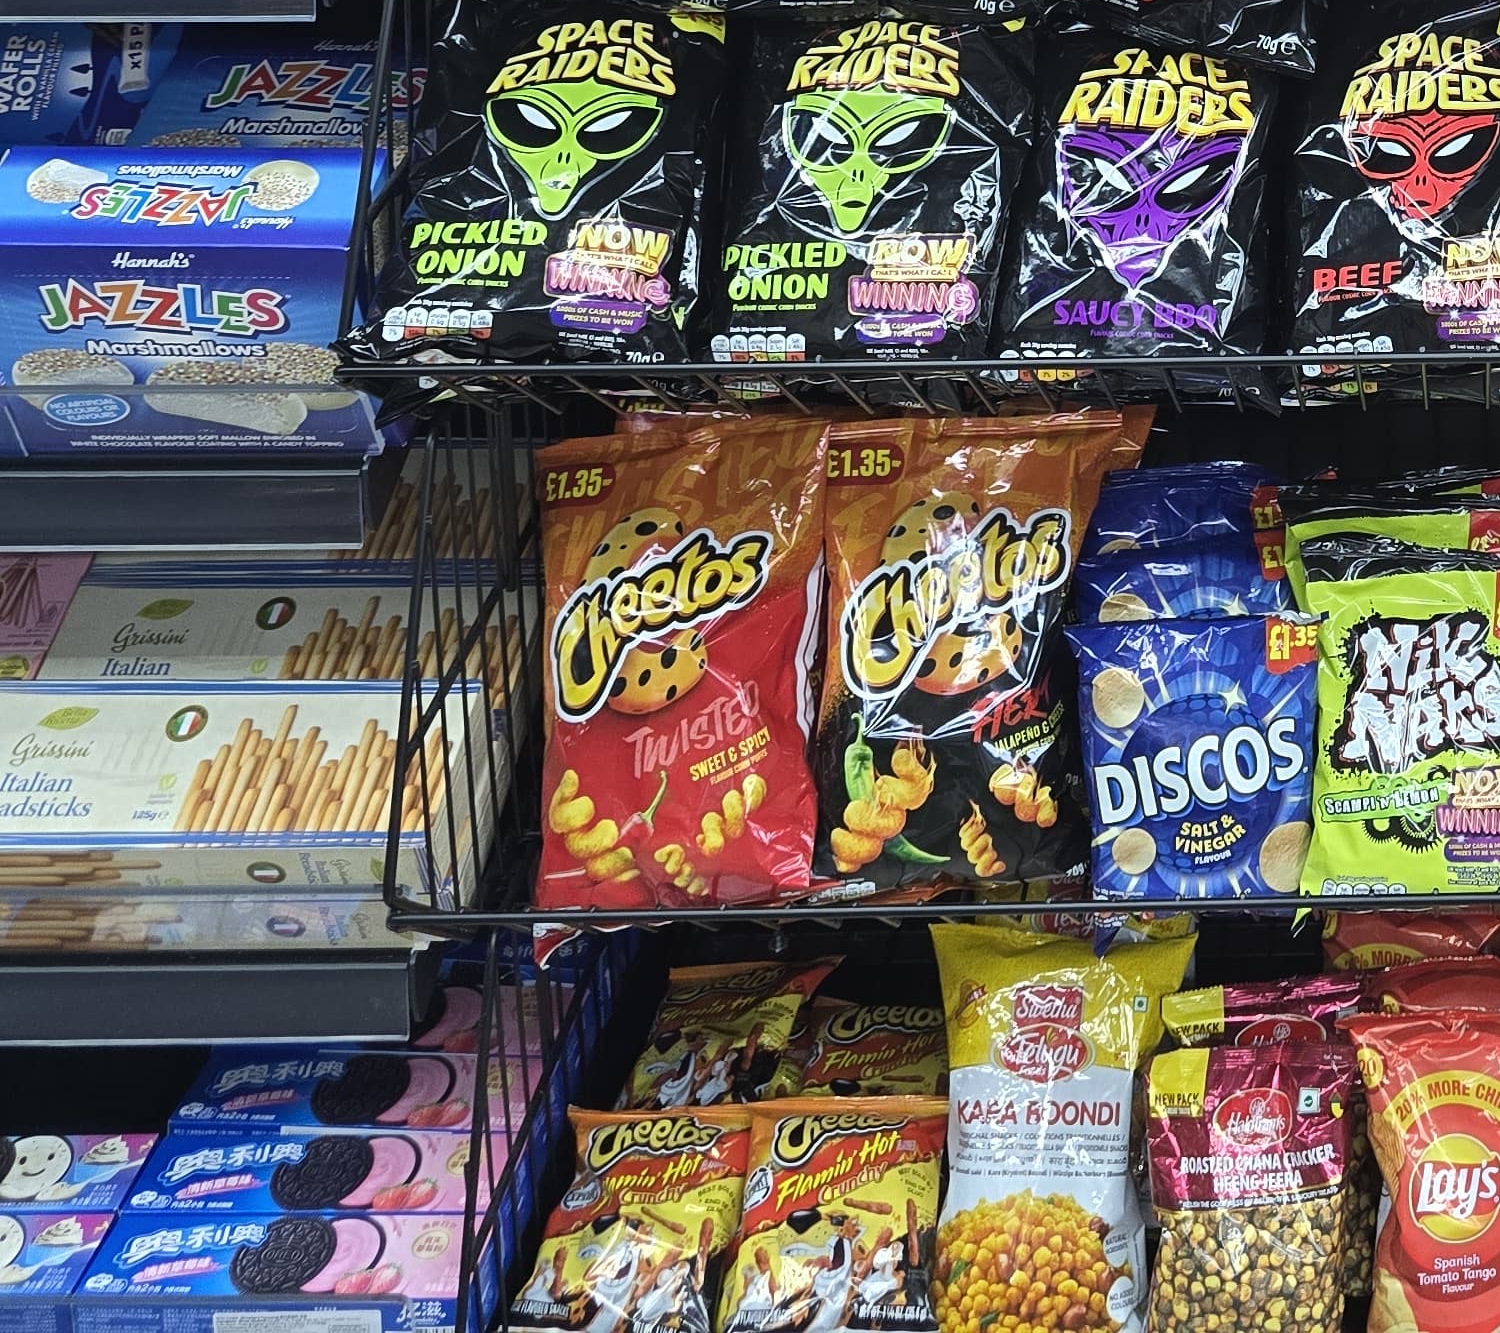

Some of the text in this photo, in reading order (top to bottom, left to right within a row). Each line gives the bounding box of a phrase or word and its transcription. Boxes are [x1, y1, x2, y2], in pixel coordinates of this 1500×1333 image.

[535, 20, 654, 47] SPACE
[486, 47, 676, 96] RAIDERS
[118, 164, 242, 178] Marshmallows
[73, 183, 253, 221] JAZZLES
[410, 221, 548, 247] PICKLED
[111, 252, 191, 270] Hannah's
[416, 248, 525, 277] ONION
[728, 274, 830, 301] ONION
[852, 281, 975, 315] WINNING
[41, 279, 286, 334] JAZZLES
[87, 340, 266, 357] Marshmallows
[100, 657, 170, 678] Italian
[624, 680, 762, 779] TWISTED
[11, 732, 92, 767] Grissini
[728, 726, 770, 763] & SPICY
[1092, 717, 1306, 826] DISCOS
[1180, 814, 1235, 836] SALT &
[1175, 824, 1247, 854] VINEGAR
[1194, 849, 1231, 865] FLAVOUR
[1426, 1077, 1474, 1099] MORE
[1181, 1151, 1233, 1174] ROASTED
[1416, 1163, 1500, 1221] Lay's
[1417, 1266, 1497, 1285] Tomato Tango
[1433, 1253, 1480, 1271] Spanish
[1441, 1282, 1475, 1294] Flavour
